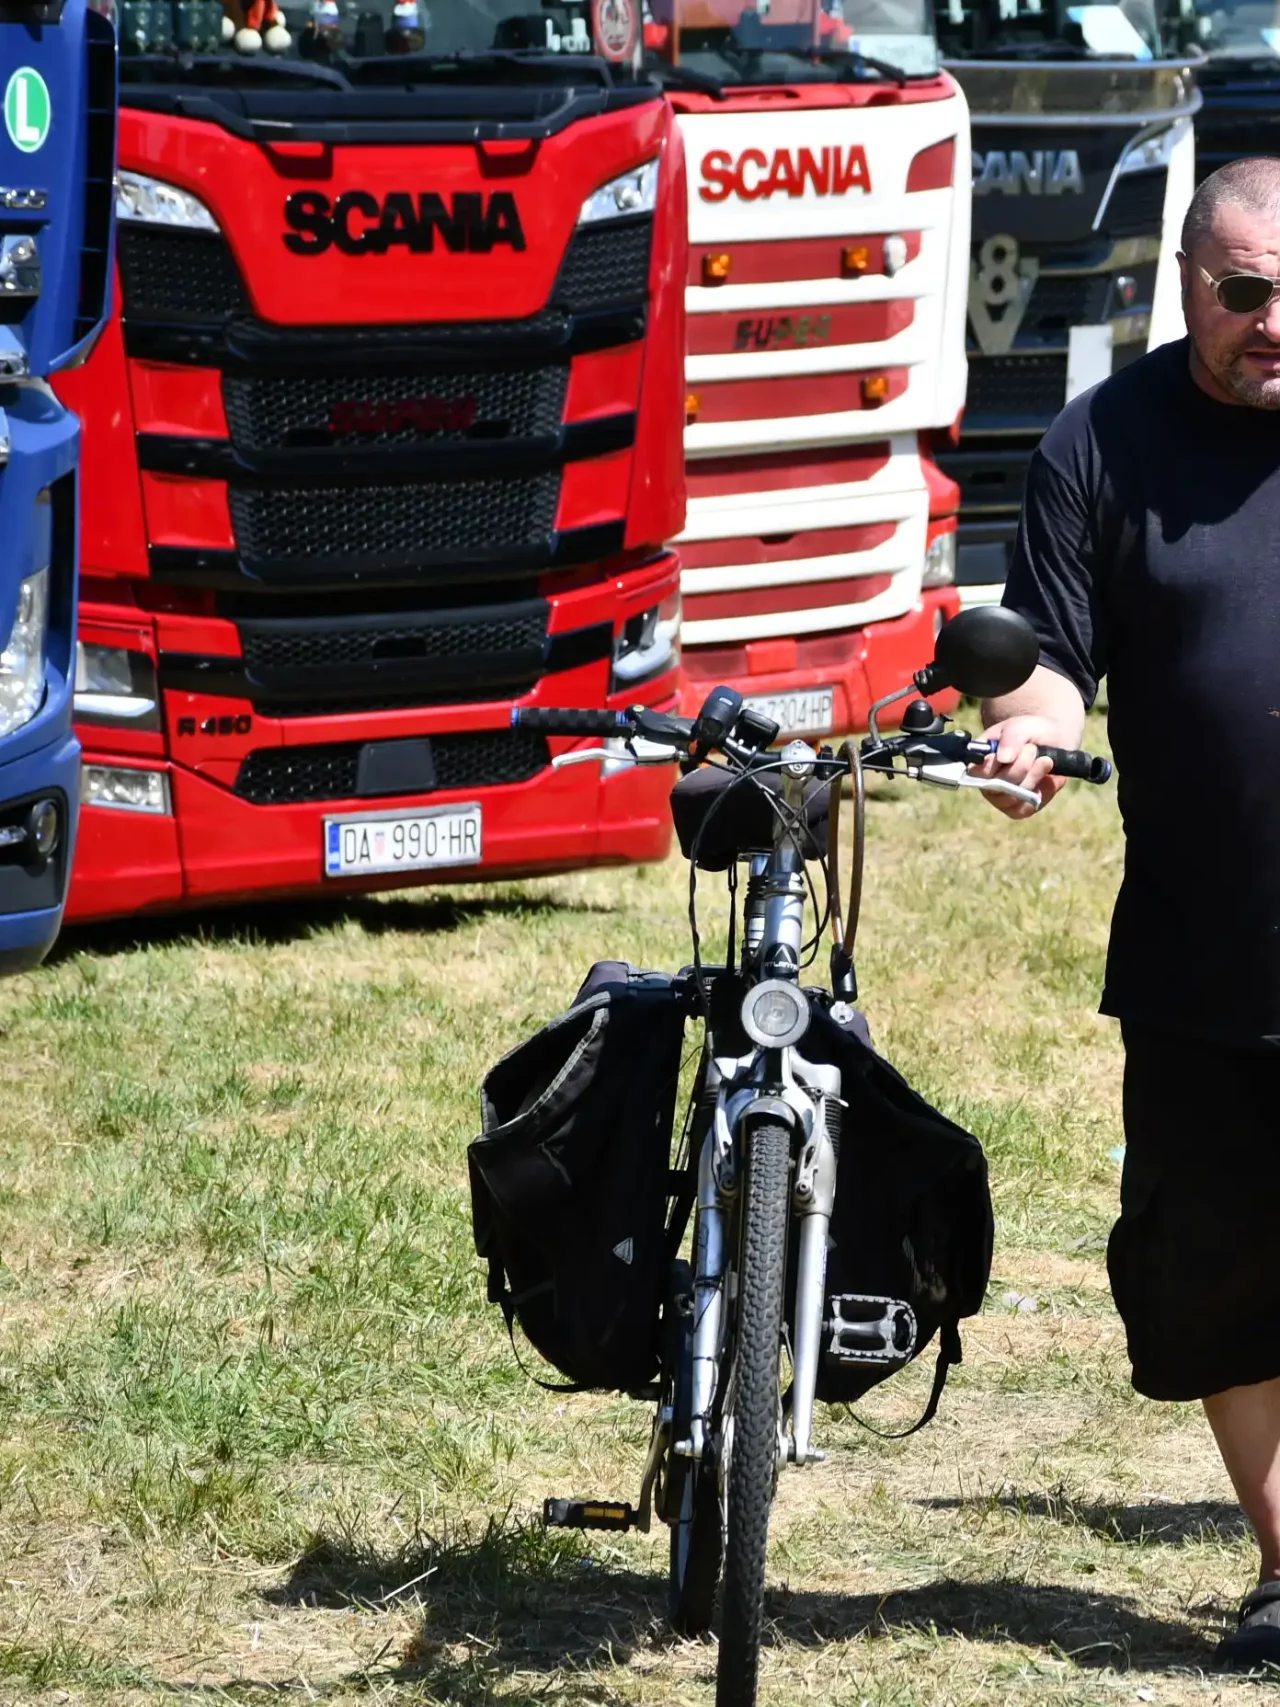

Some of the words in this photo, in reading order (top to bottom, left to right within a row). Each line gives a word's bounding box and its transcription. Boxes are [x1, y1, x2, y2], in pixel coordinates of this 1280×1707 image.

[16, 77, 40, 142] L
[699, 144, 872, 202] SCANIA
[971, 150, 1085, 195] ANIA
[283, 190, 526, 256] SCANIA
[736, 314, 832, 349] SUPER
[344, 827, 371, 864] DA
